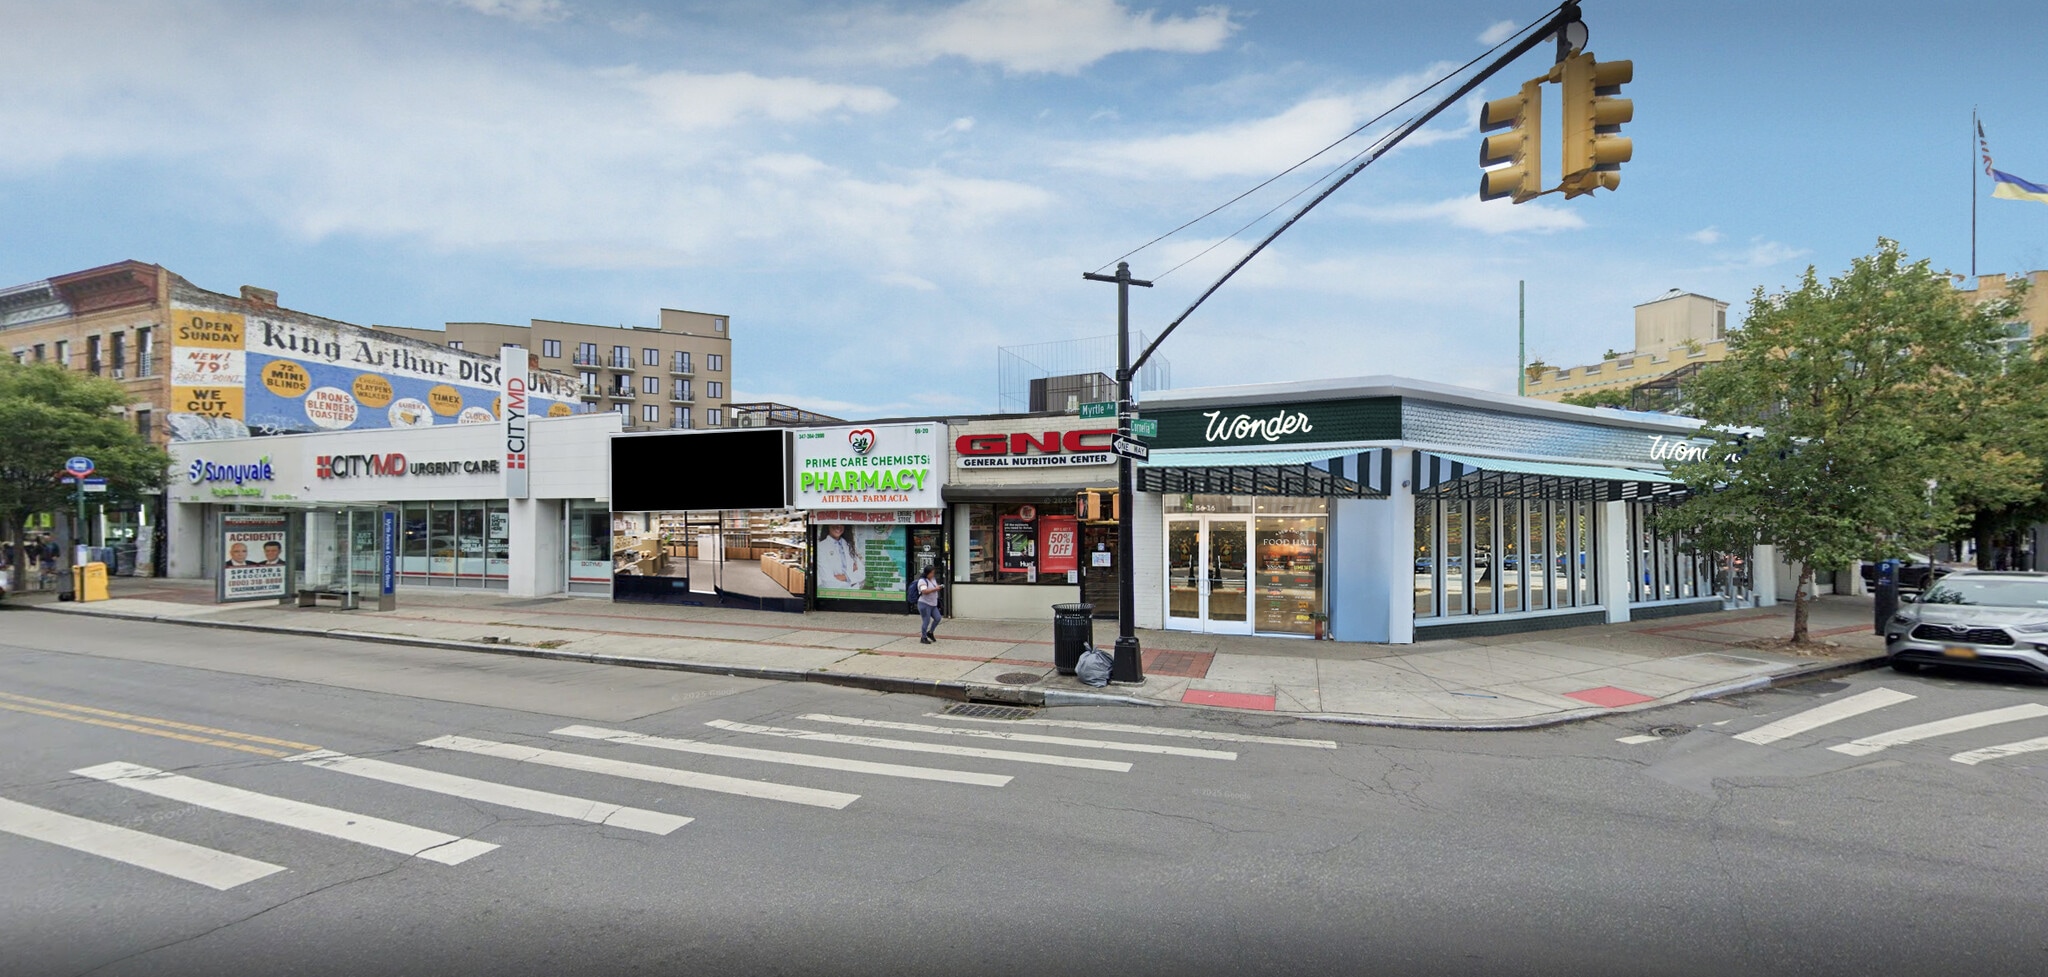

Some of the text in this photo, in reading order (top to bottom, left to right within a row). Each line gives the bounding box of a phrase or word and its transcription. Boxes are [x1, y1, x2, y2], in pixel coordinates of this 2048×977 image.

[192, 317, 233, 332] OPEN
[179, 327, 240, 343] SUNDAY
[260, 320, 342, 363] King
[353, 340, 450, 377] Arthur
[271, 370, 304, 381] MINI
[266, 378, 307, 391] BLINDS
[356, 383, 392, 394] PLAYPENS
[193, 390, 221, 401] WE
[316, 392, 350, 404] IRONS
[356, 391, 390, 400] WALKERS
[432, 393, 460, 404] TIMEX
[187, 401, 227, 412] CUT
[307, 400, 355, 413] BLENDERS
[398, 402, 427, 410] EUREKA
[1082, 404, 1104, 417] Myrtle
[309, 410, 354, 421] TOASTERS
[507, 377, 526, 453] CITYMD
[1131, 421, 1150, 433] Cornelia
[1203, 410, 1313, 442] Wonder
[956, 429, 1118, 455] GNC
[1117, 441, 1145, 456] ONE WAY
[332, 453, 499, 477] CITYMD URGENT CARE
[806, 458, 837, 468] PRIME
[841, 457, 868, 467] CARE
[871, 455, 927, 466] CHEMISTS
[964, 454, 1108, 467] GENERAL NUTRITION CENTER
[205, 459, 272, 485] Sunnyvale
[801, 468, 928, 492] PHARMACY
[863, 494, 909, 502] FARMACIA
[868, 512, 896, 522] SPECIAL
[229, 533, 284, 542] ACCIDENT?
[1051, 533, 1071, 544] 50%
[1263, 538, 1318, 547] FOOD HALL
[1053, 544, 1070, 555] OFF
[1882, 563, 1890, 571] P
